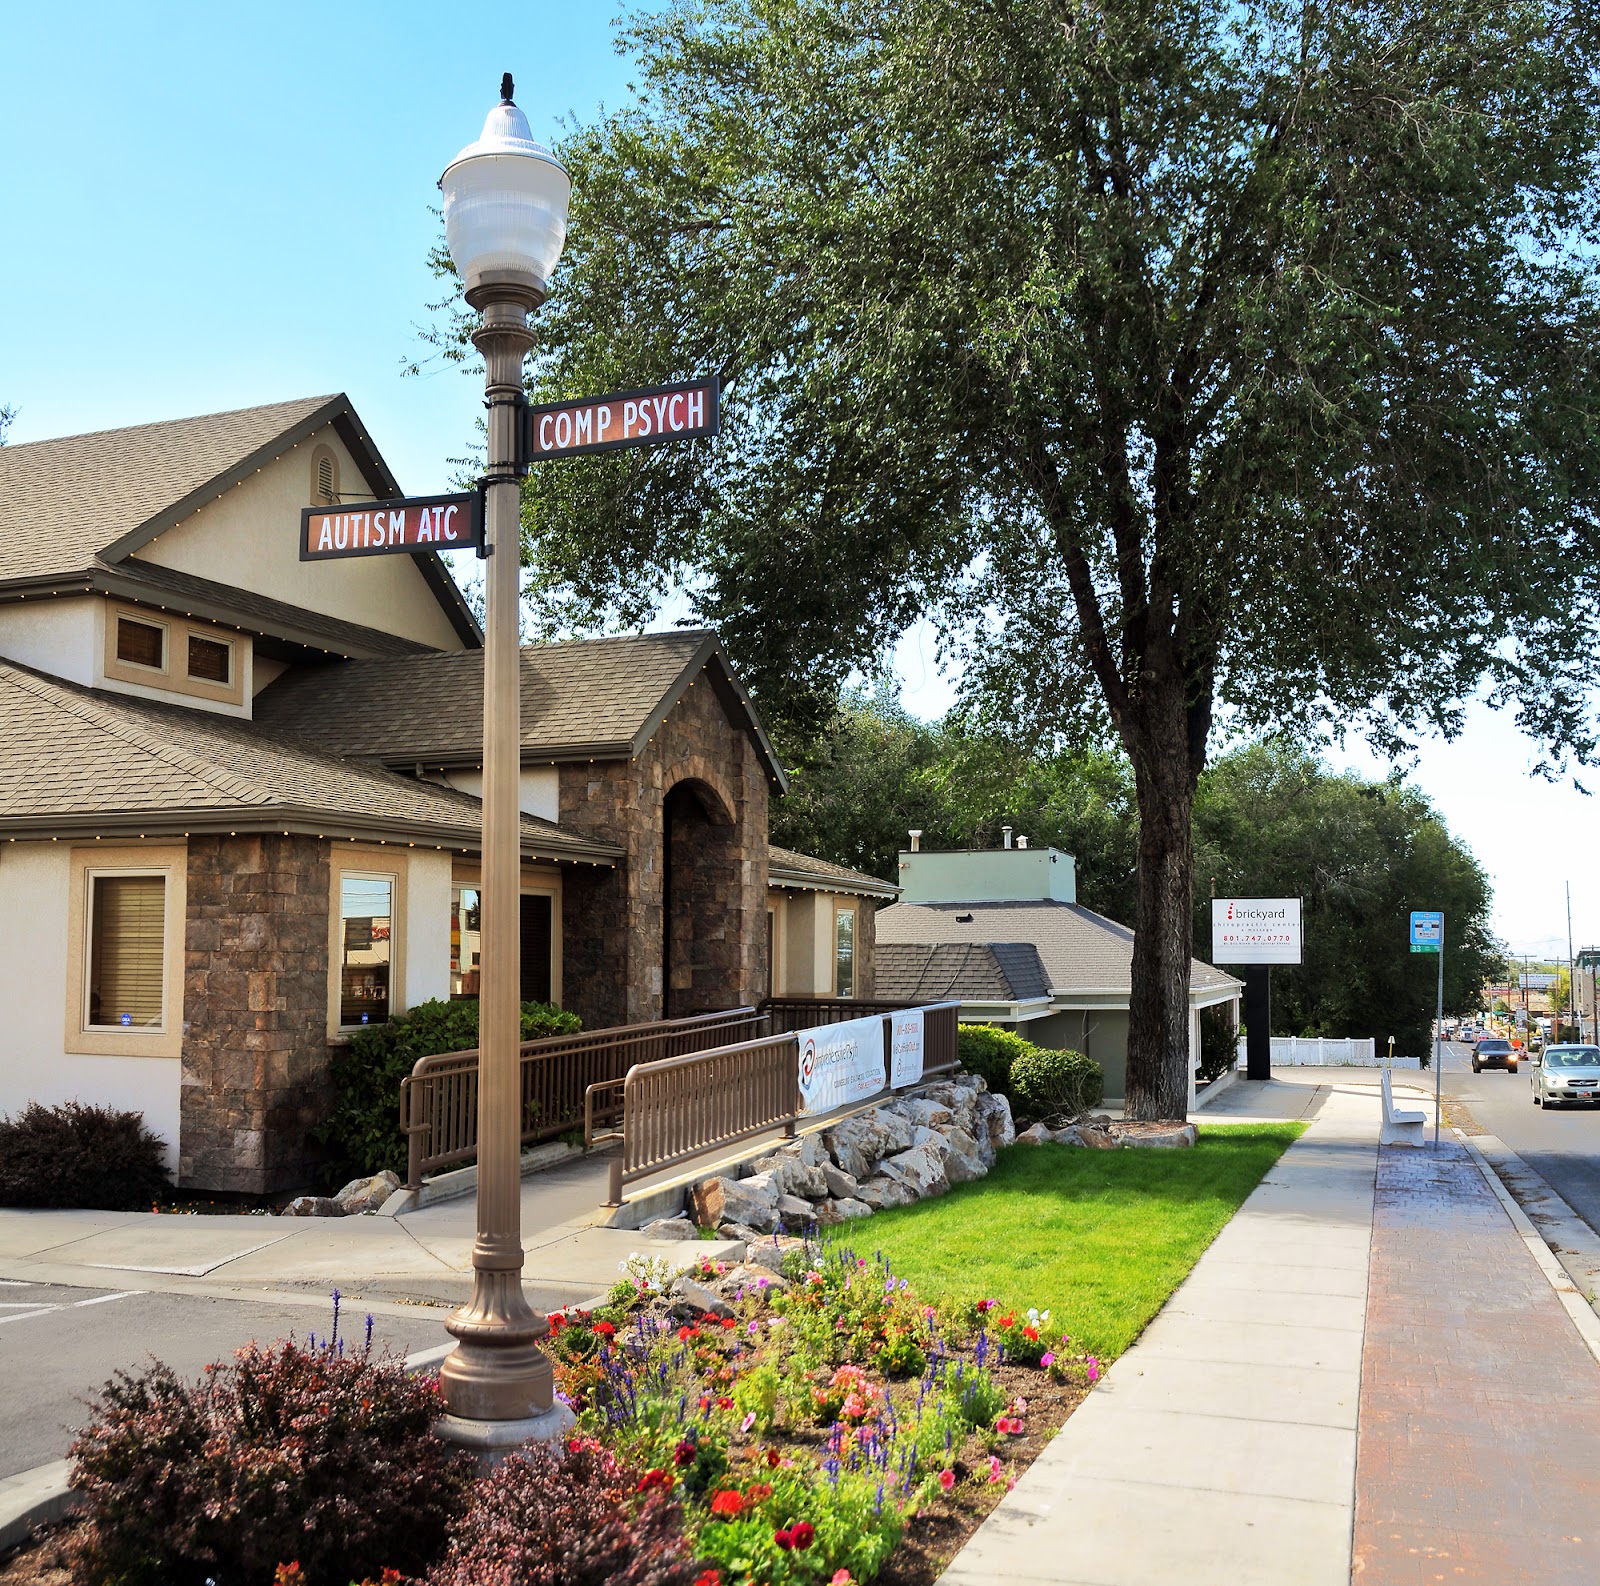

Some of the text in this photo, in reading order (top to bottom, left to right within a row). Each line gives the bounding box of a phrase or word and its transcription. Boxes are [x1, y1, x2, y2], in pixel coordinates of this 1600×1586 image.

[539, 390, 704, 451] COMP PSYCH
[317, 504, 459, 551] AUTISM ATC
[1236, 909, 1285, 920] brickyard
[1412, 945, 1421, 953] 33
